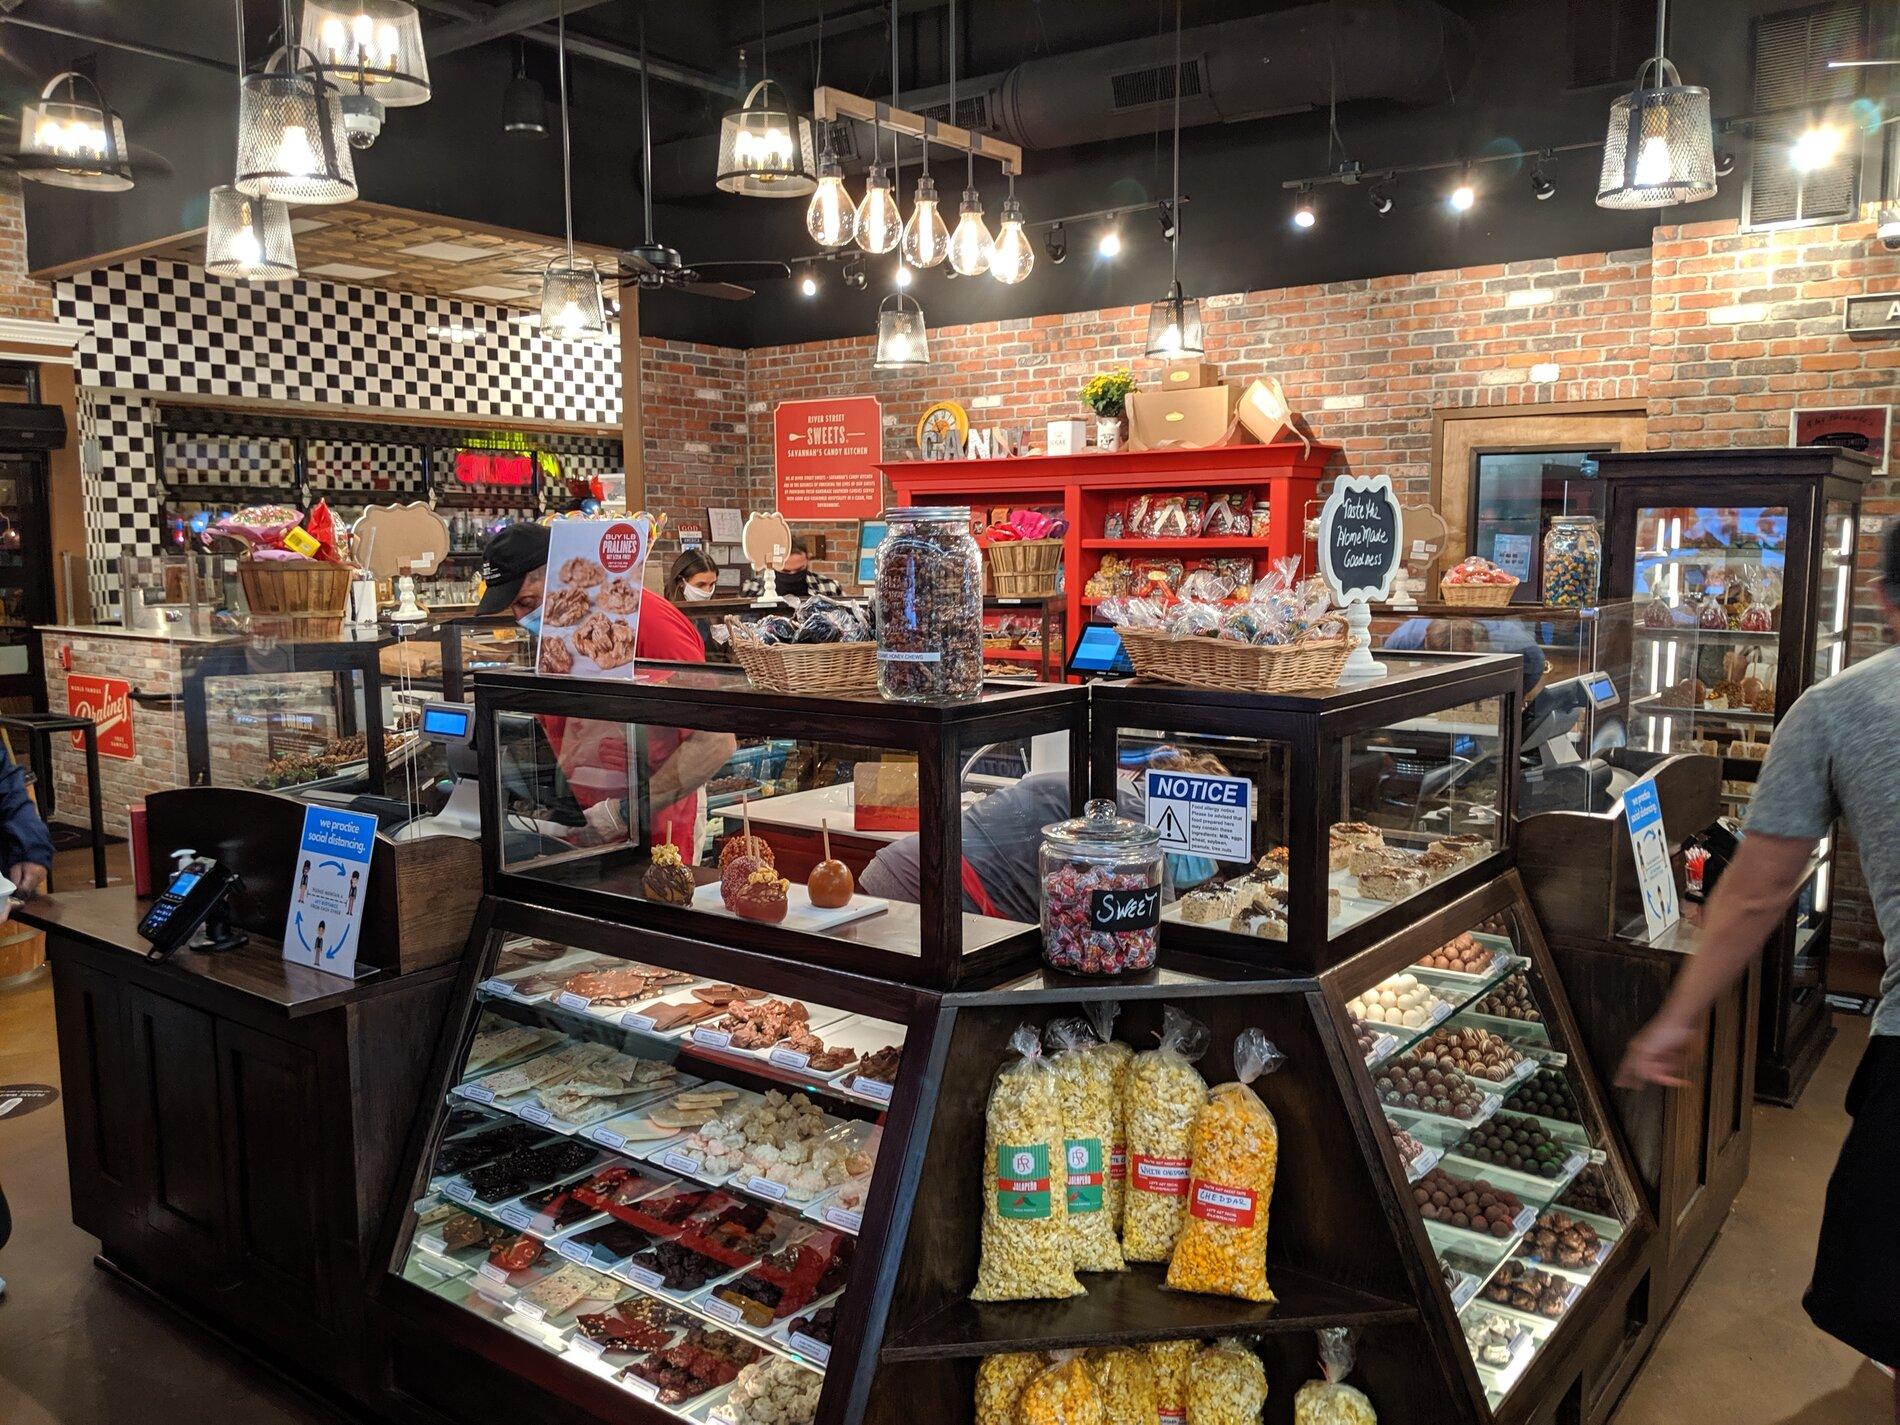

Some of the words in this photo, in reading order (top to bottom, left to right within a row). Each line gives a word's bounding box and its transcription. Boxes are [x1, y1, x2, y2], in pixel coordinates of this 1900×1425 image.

[808, 416, 824, 424] RIVER
[825, 414, 844, 423] STREET
[788, 448, 822, 458] SAVANNAH'S
[824, 448, 842, 456] CANDY
[844, 447, 868, 456] KITCHEN
[602, 540, 637, 554] PRALINES
[1157, 778, 1238, 804] NOTICE
[320, 818, 331, 829] we
[331, 820, 360, 834] practice
[308, 831, 327, 844] social
[328, 833, 366, 854] distancing.
[1096, 892, 1158, 922] SWEET
[1200, 1191, 1246, 1206] CHEDDAR
